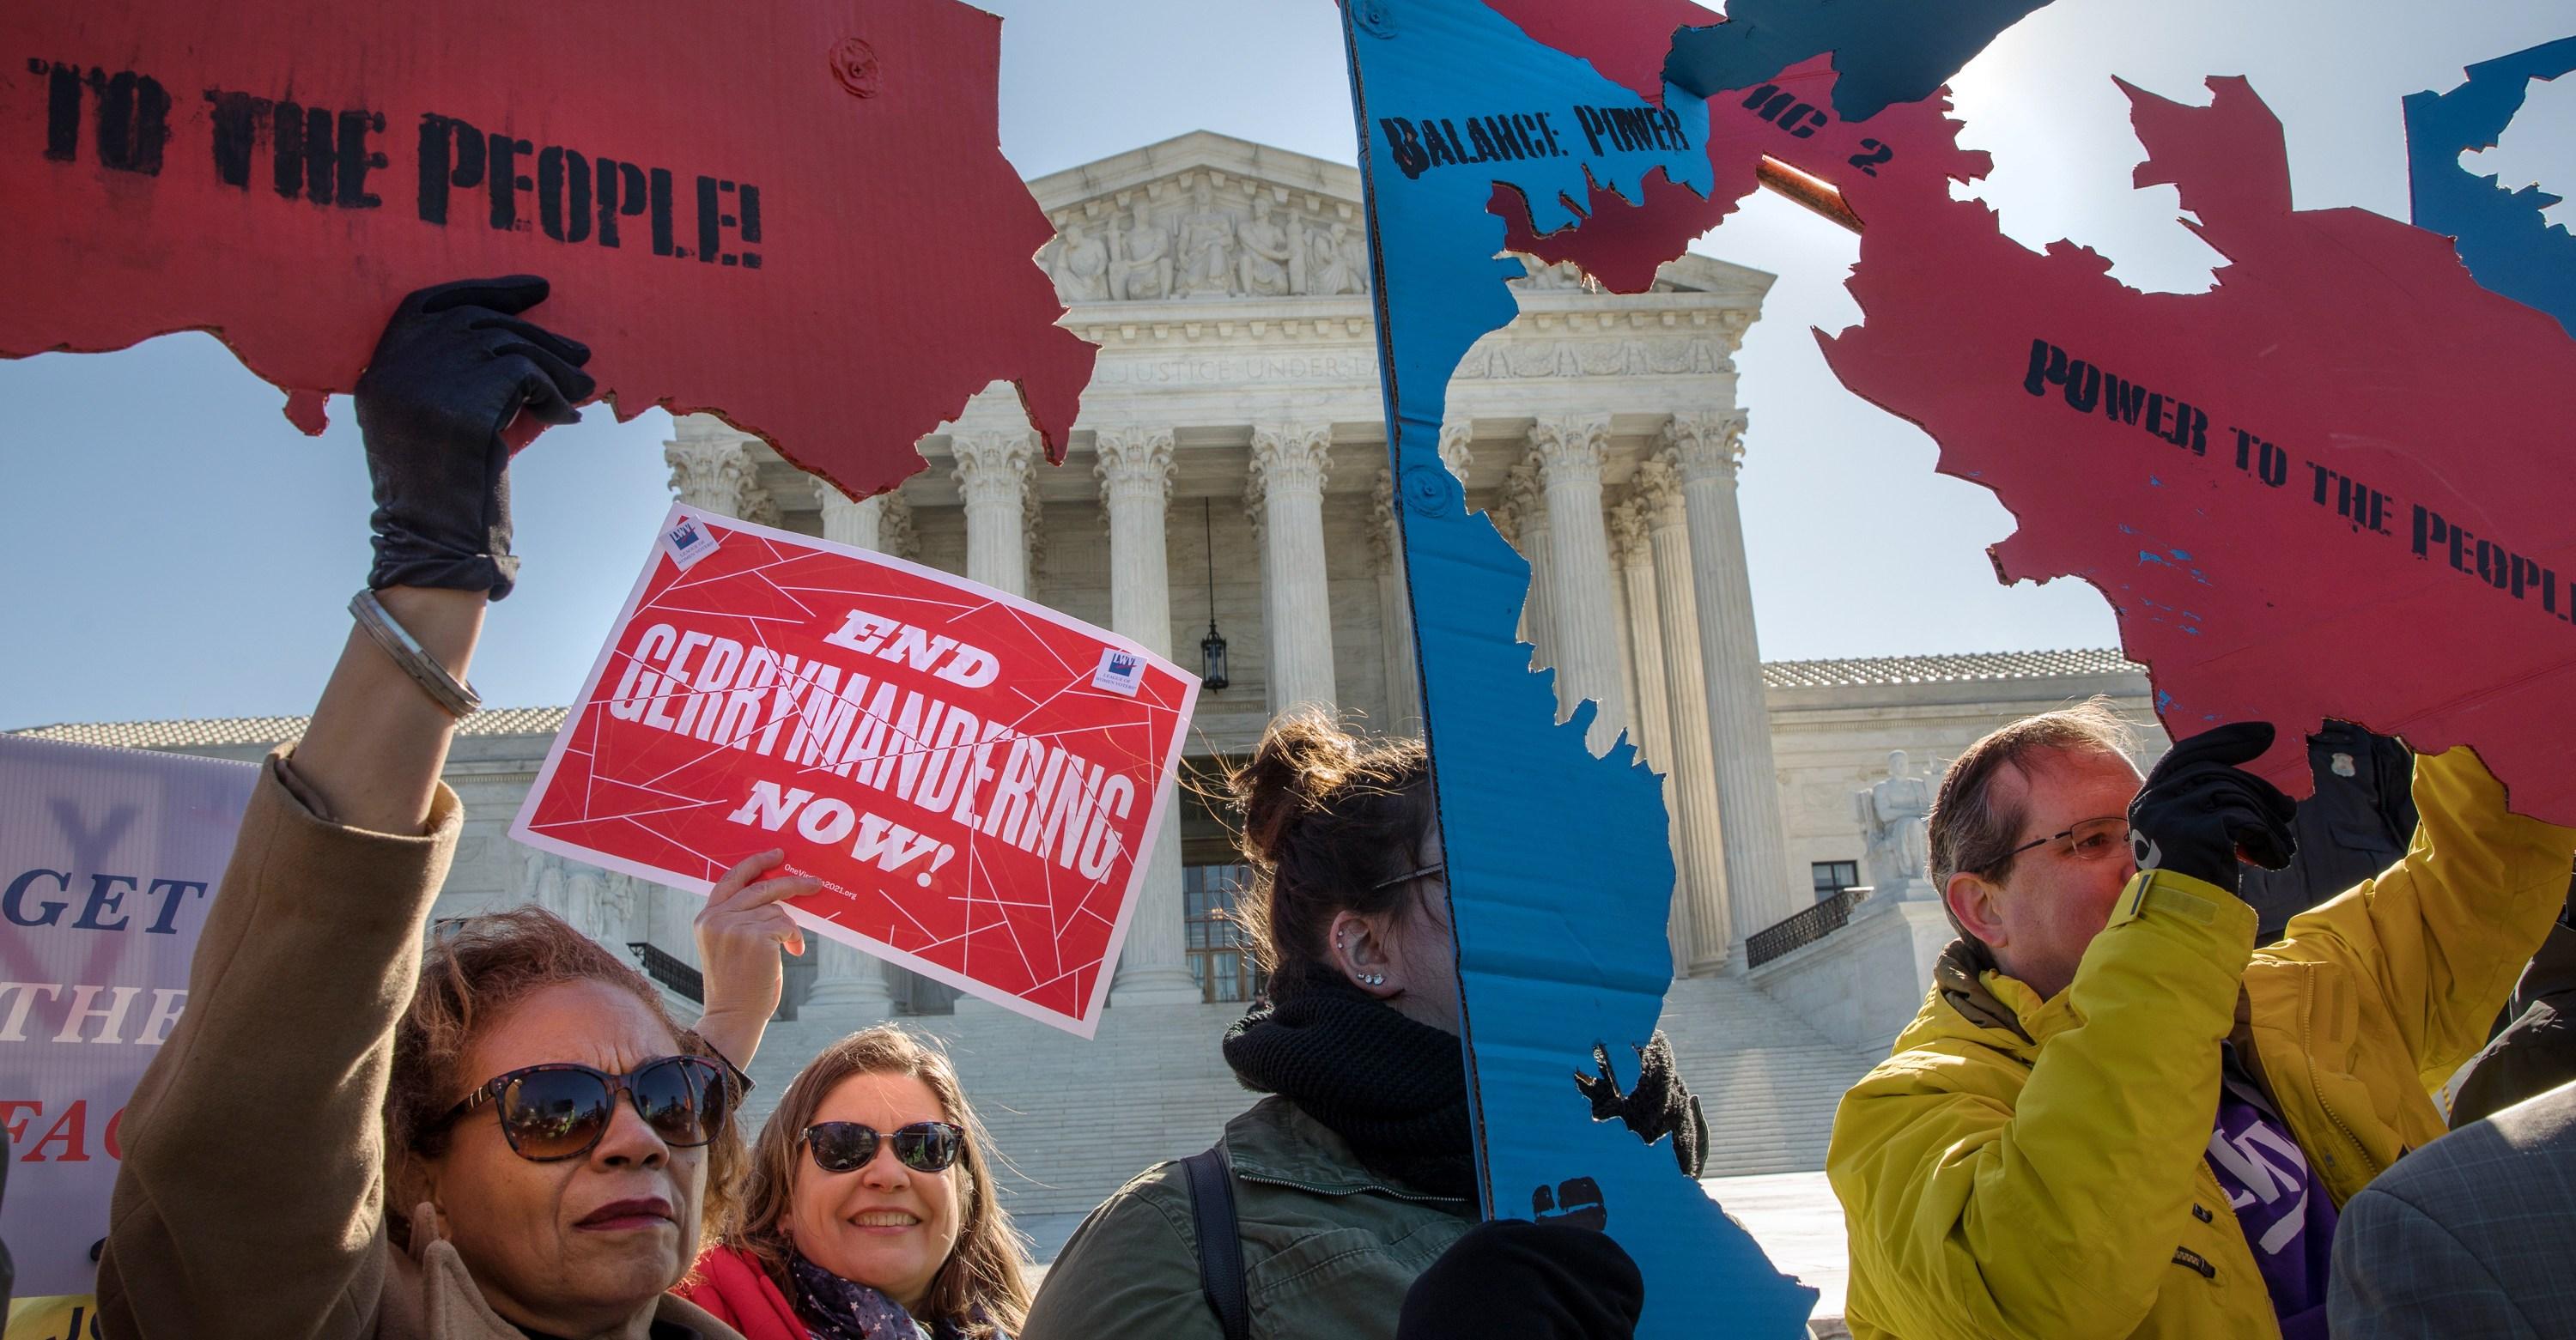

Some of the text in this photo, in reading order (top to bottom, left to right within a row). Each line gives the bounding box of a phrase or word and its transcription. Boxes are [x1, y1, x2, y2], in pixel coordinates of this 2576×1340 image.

[27, 58, 762, 269] TO THE PEOPLE!
[1379, 105, 1690, 179] BALANCE POWER
[1848, 138, 1893, 177] 2
[1123, 359, 1231, 384] JUSTICE
[1246, 356, 1338, 380] UNDER
[2024, 338, 2208, 457] POWER
[2229, 427, 2287, 488] TO
[2306, 460, 2393, 536] THE
[823, 609, 999, 688] END
[610, 623, 1134, 886] GERRYMANDERING
[726, 780, 955, 888] NOW!
[3, 869, 208, 934] GET
[784, 864, 857, 900] OneVir2021.org
[0, 1100, 123, 1162] FA
